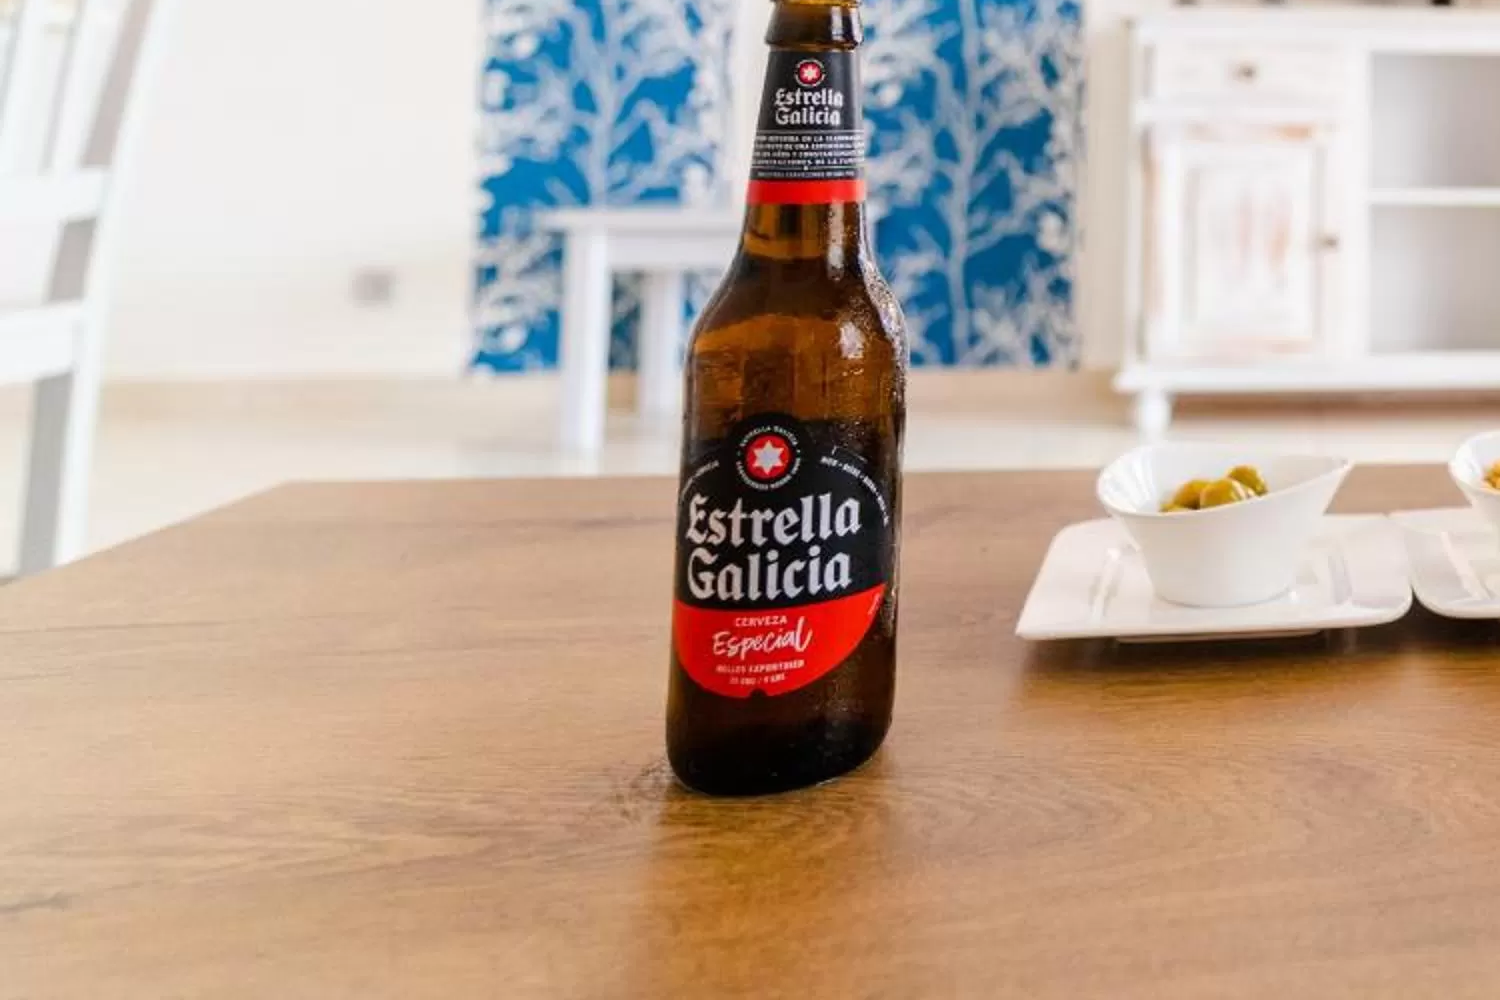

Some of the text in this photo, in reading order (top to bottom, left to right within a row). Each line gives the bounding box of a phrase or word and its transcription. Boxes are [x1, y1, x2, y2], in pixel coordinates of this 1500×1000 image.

[774, 87, 844, 107] Estrella
[775, 106, 841, 126] Galicia
[686, 492, 862, 547] Estrella
[687, 545, 853, 601] Galicia
[735, 615, 788, 627] CERVEZA
[712, 616, 813, 660] Especial
